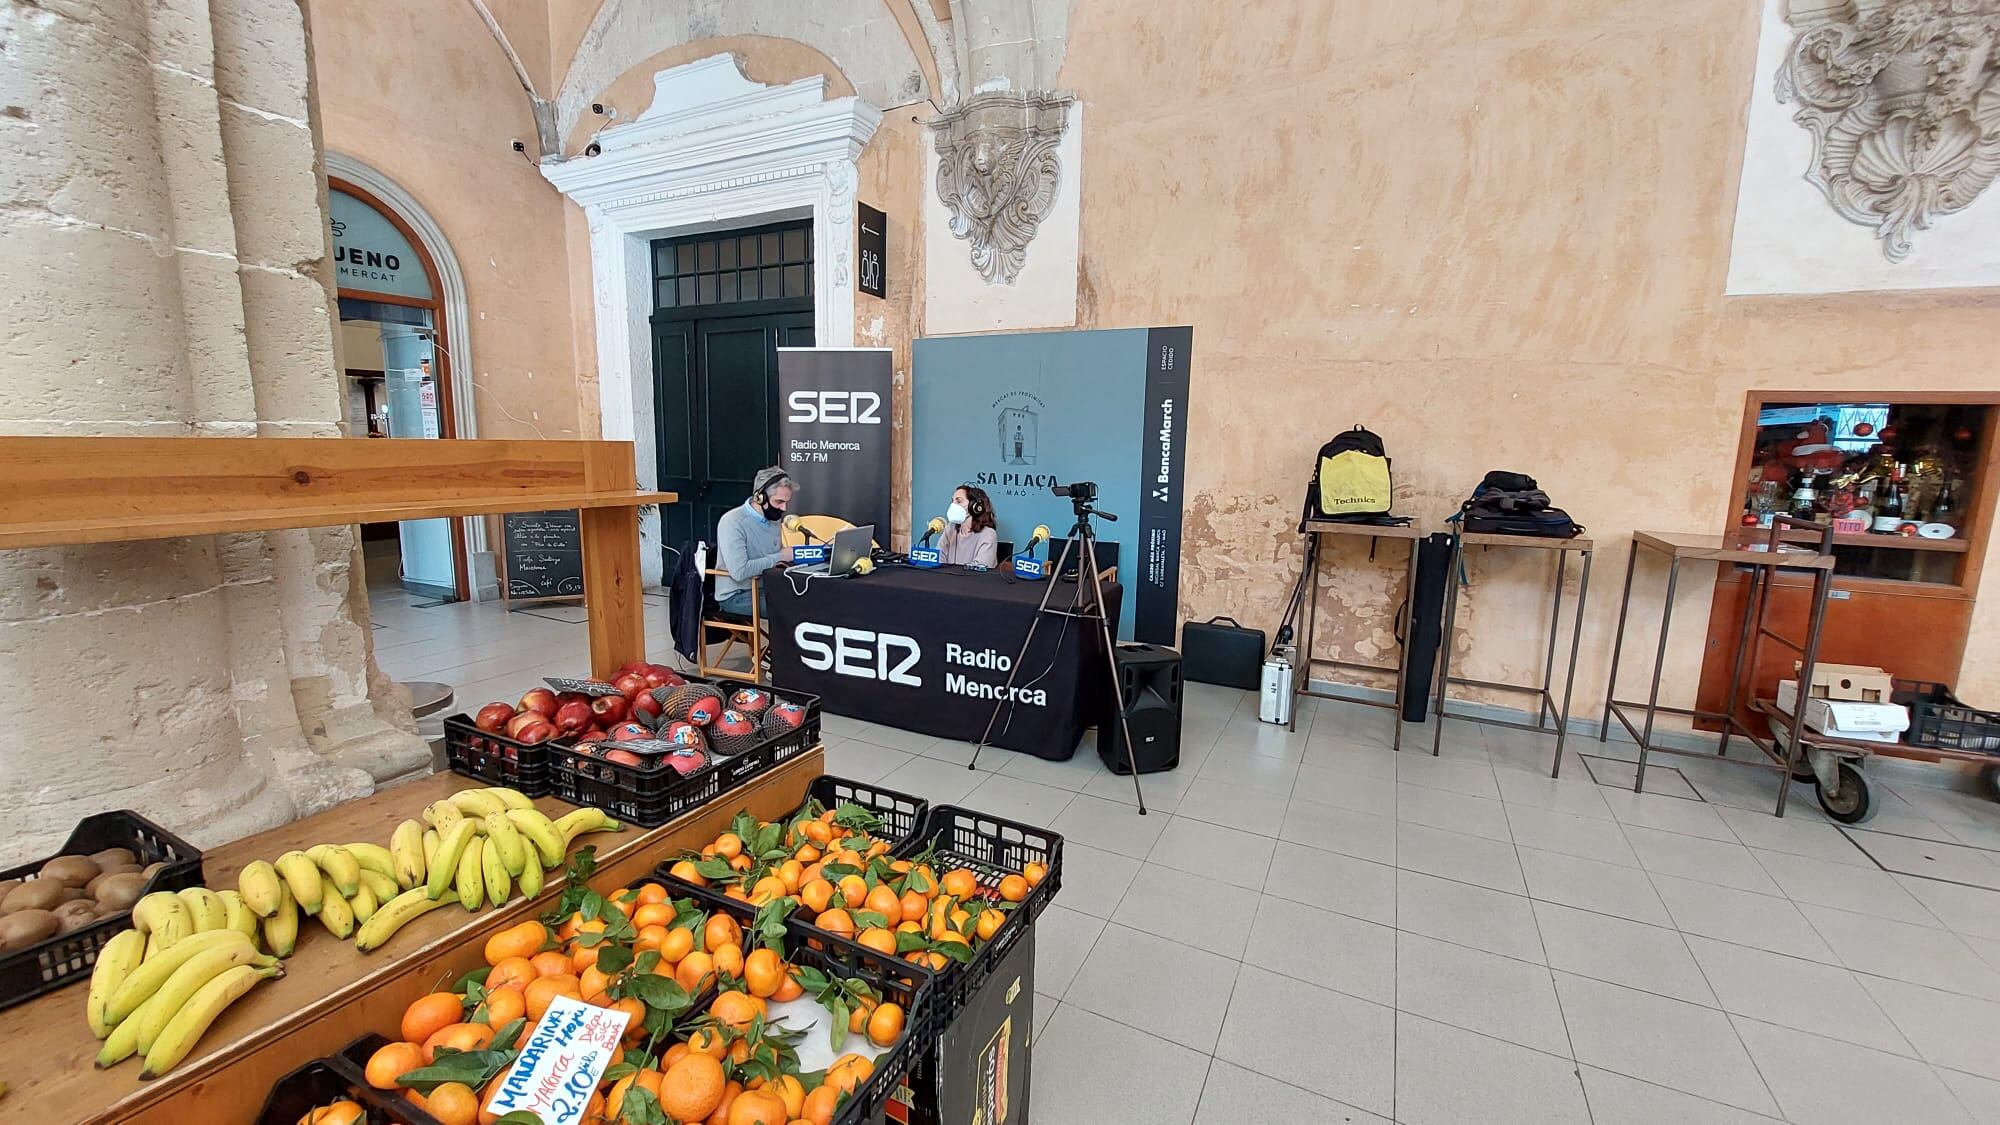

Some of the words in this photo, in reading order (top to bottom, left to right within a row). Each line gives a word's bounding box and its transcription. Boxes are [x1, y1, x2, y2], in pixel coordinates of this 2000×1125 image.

[340, 266, 396, 282] MERCAT
[788, 391, 882, 424] SER
[791, 440, 818, 450] Radio
[819, 440, 861, 451] Menorca
[1158, 399, 1173, 484] BancaMarch
[790, 453, 811, 462] 95.7
[813, 453, 828, 462] FM
[976, 472, 998, 485] SA
[1003, 473, 1058, 491] PLAÇA
[1006, 489, 1026, 497] MAÓ
[1334, 496, 1376, 505] Technics
[795, 548, 823, 559] SER
[912, 549, 938, 563] SER
[1016, 559, 1041, 575] SER
[794, 621, 922, 688] SER
[945, 643, 1012, 673] Radio
[945, 673, 1048, 707] Menorca
[495, 1009, 565, 1109] MANDARINA
